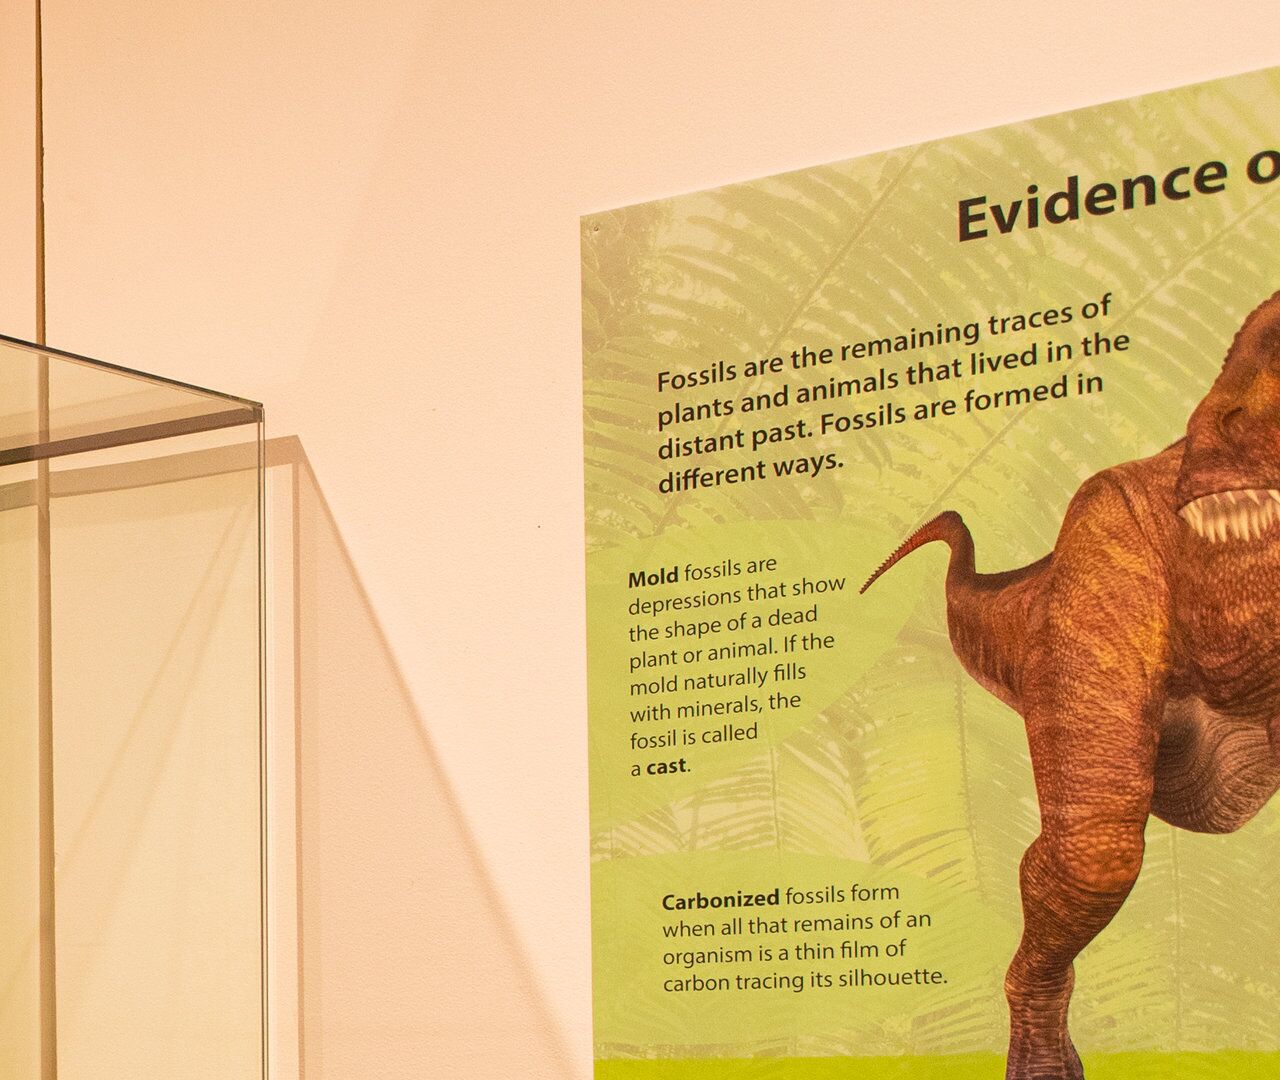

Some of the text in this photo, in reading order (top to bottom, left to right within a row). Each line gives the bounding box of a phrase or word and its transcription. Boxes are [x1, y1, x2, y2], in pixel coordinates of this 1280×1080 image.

[959, 161, 1227, 242] Evidence
[659, 293, 1111, 392] Fossils are the remaining traces of
[659, 333, 1129, 431] plants and animals that lived in the
[659, 374, 1102, 459] distant past. Fossils are formed in
[659, 454, 843, 493] different ways.
[629, 559, 776, 588] Mold fossils are
[629, 578, 845, 616] depressions that show
[629, 604, 817, 642] the shape of a dead
[631, 633, 834, 673] plant or animal. If the
[631, 663, 806, 695] mold naturally fills
[663, 884, 898, 910] Carbonized fossils form
[663, 910, 930, 937] when all that remains of an
[664, 939, 907, 968] organism is a thin film of
[664, 969, 947, 992] carbon tracing its silhouette.
